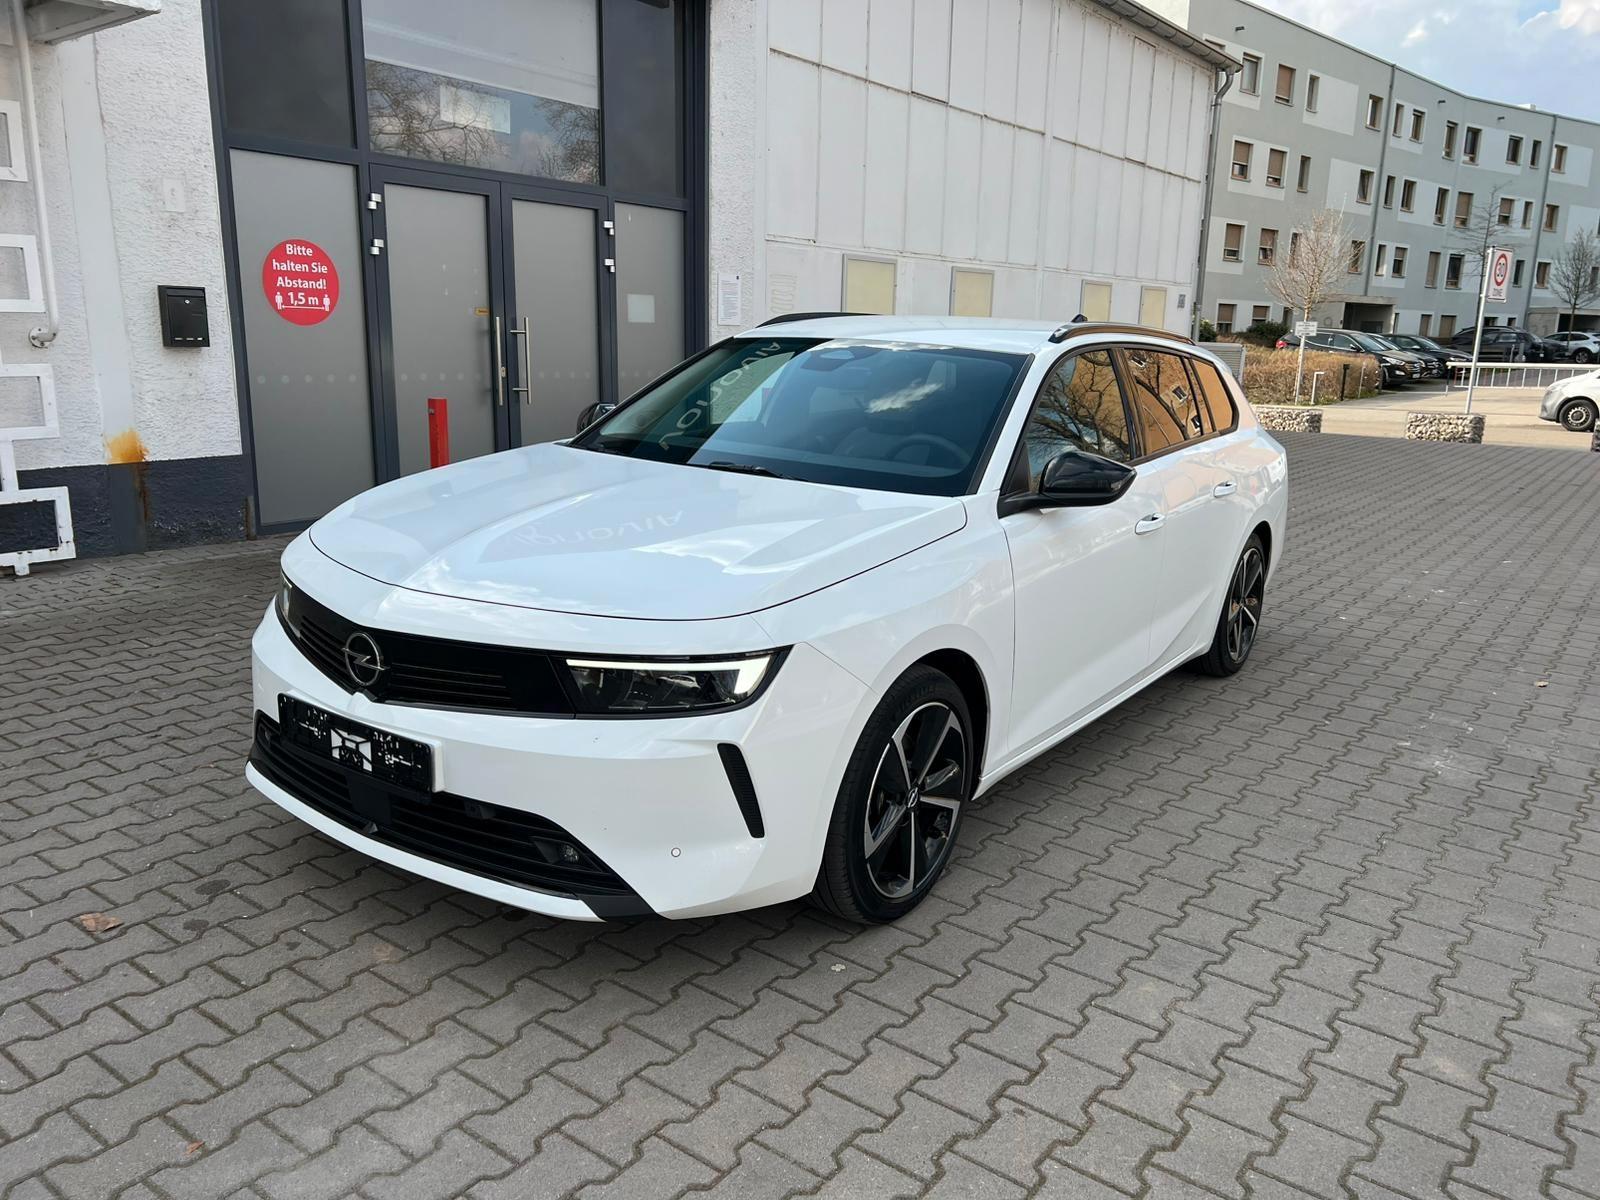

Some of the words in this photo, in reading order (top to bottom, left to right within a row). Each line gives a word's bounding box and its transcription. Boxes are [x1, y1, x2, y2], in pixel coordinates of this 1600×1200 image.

[286, 244, 313, 257] Bitte
[272, 259, 309, 273] halten
[311, 262, 328, 273] Sie
[1496, 262, 1505, 277] 30
[276, 276, 327, 290] Abstand!
[287, 292, 306, 306] 1,5
[308, 295, 319, 305] m
